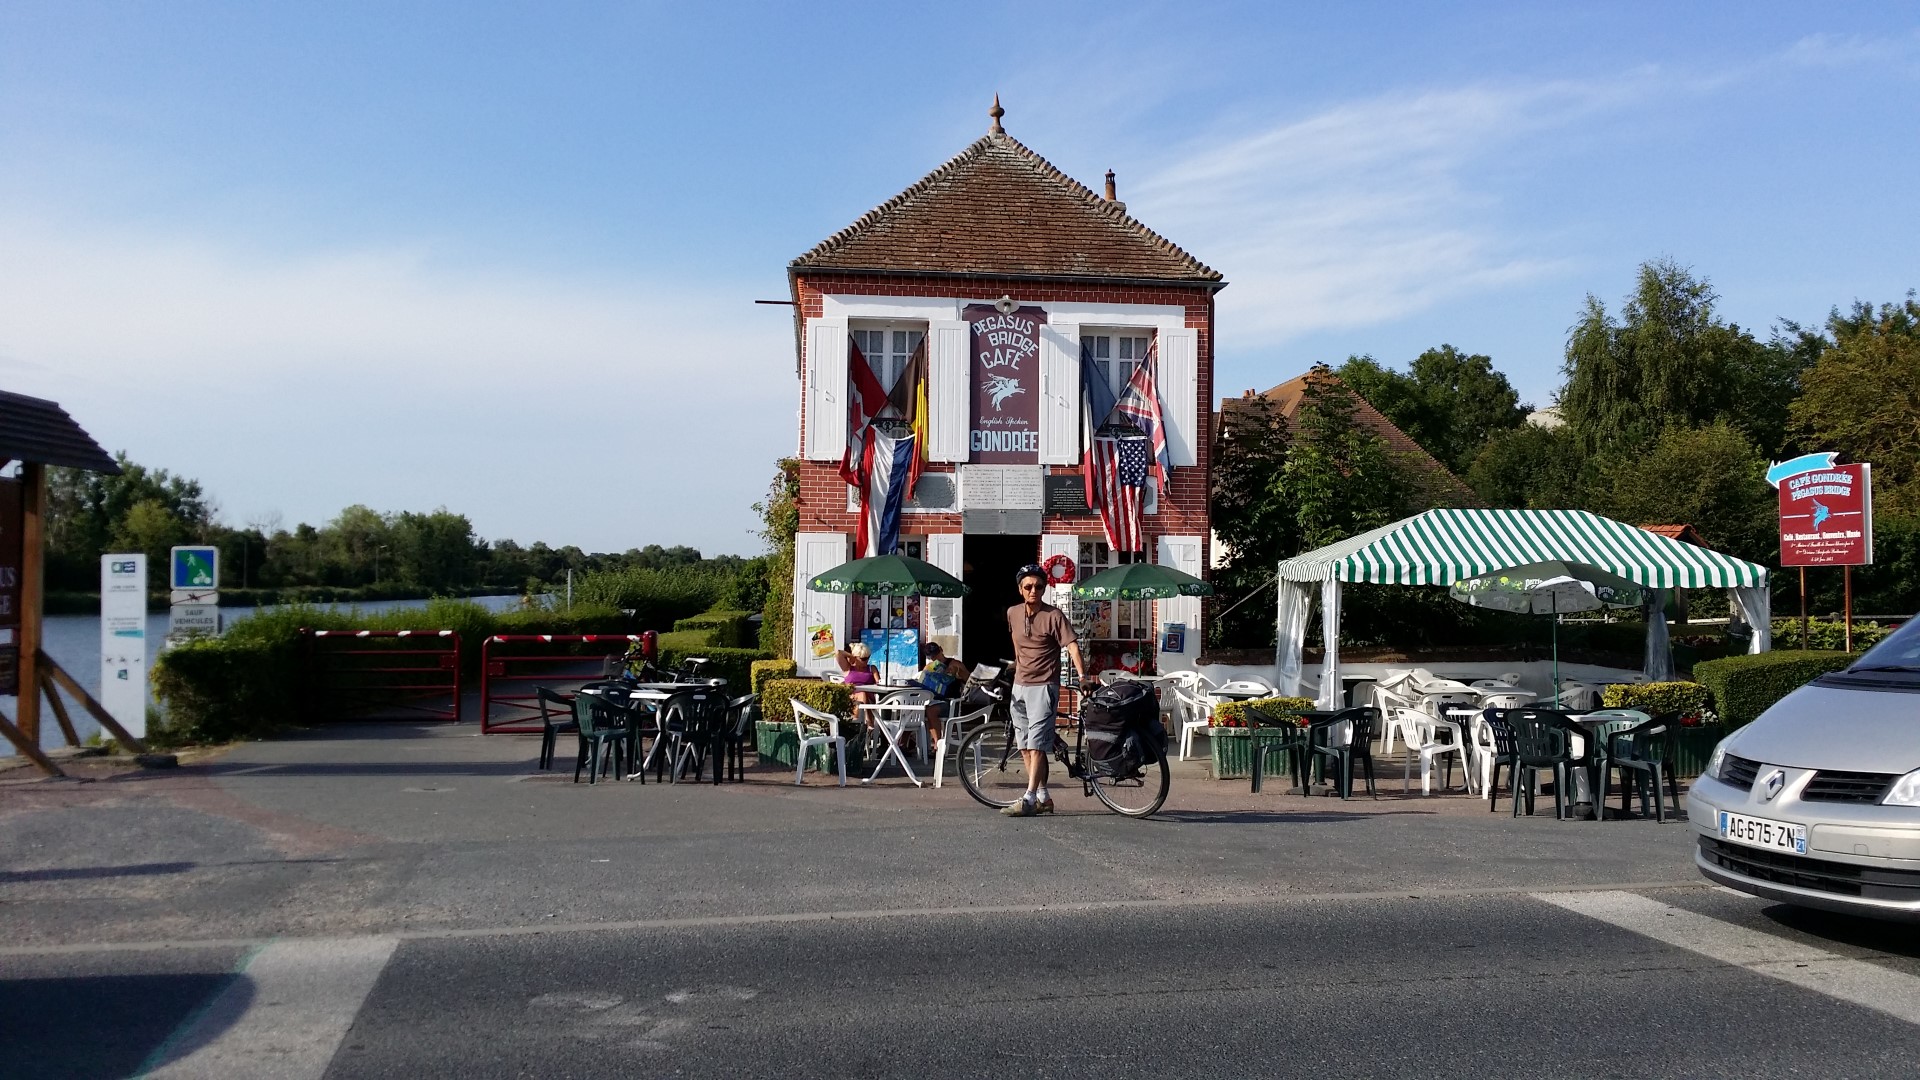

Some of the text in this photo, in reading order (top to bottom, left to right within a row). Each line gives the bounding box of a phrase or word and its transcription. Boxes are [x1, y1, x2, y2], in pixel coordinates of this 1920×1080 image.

[972, 315, 1034, 336] PEGASUS
[988, 331, 1038, 357] BRIDGE
[980, 348, 1024, 370] CAFÉ
[980, 416, 1028, 427] English Spoken
[970, 428, 1038, 452] GONDRÉE
[1789, 471, 1853, 490] CAFÉ GONDRÉE
[1824, 485, 1851, 496] BRIDGE
